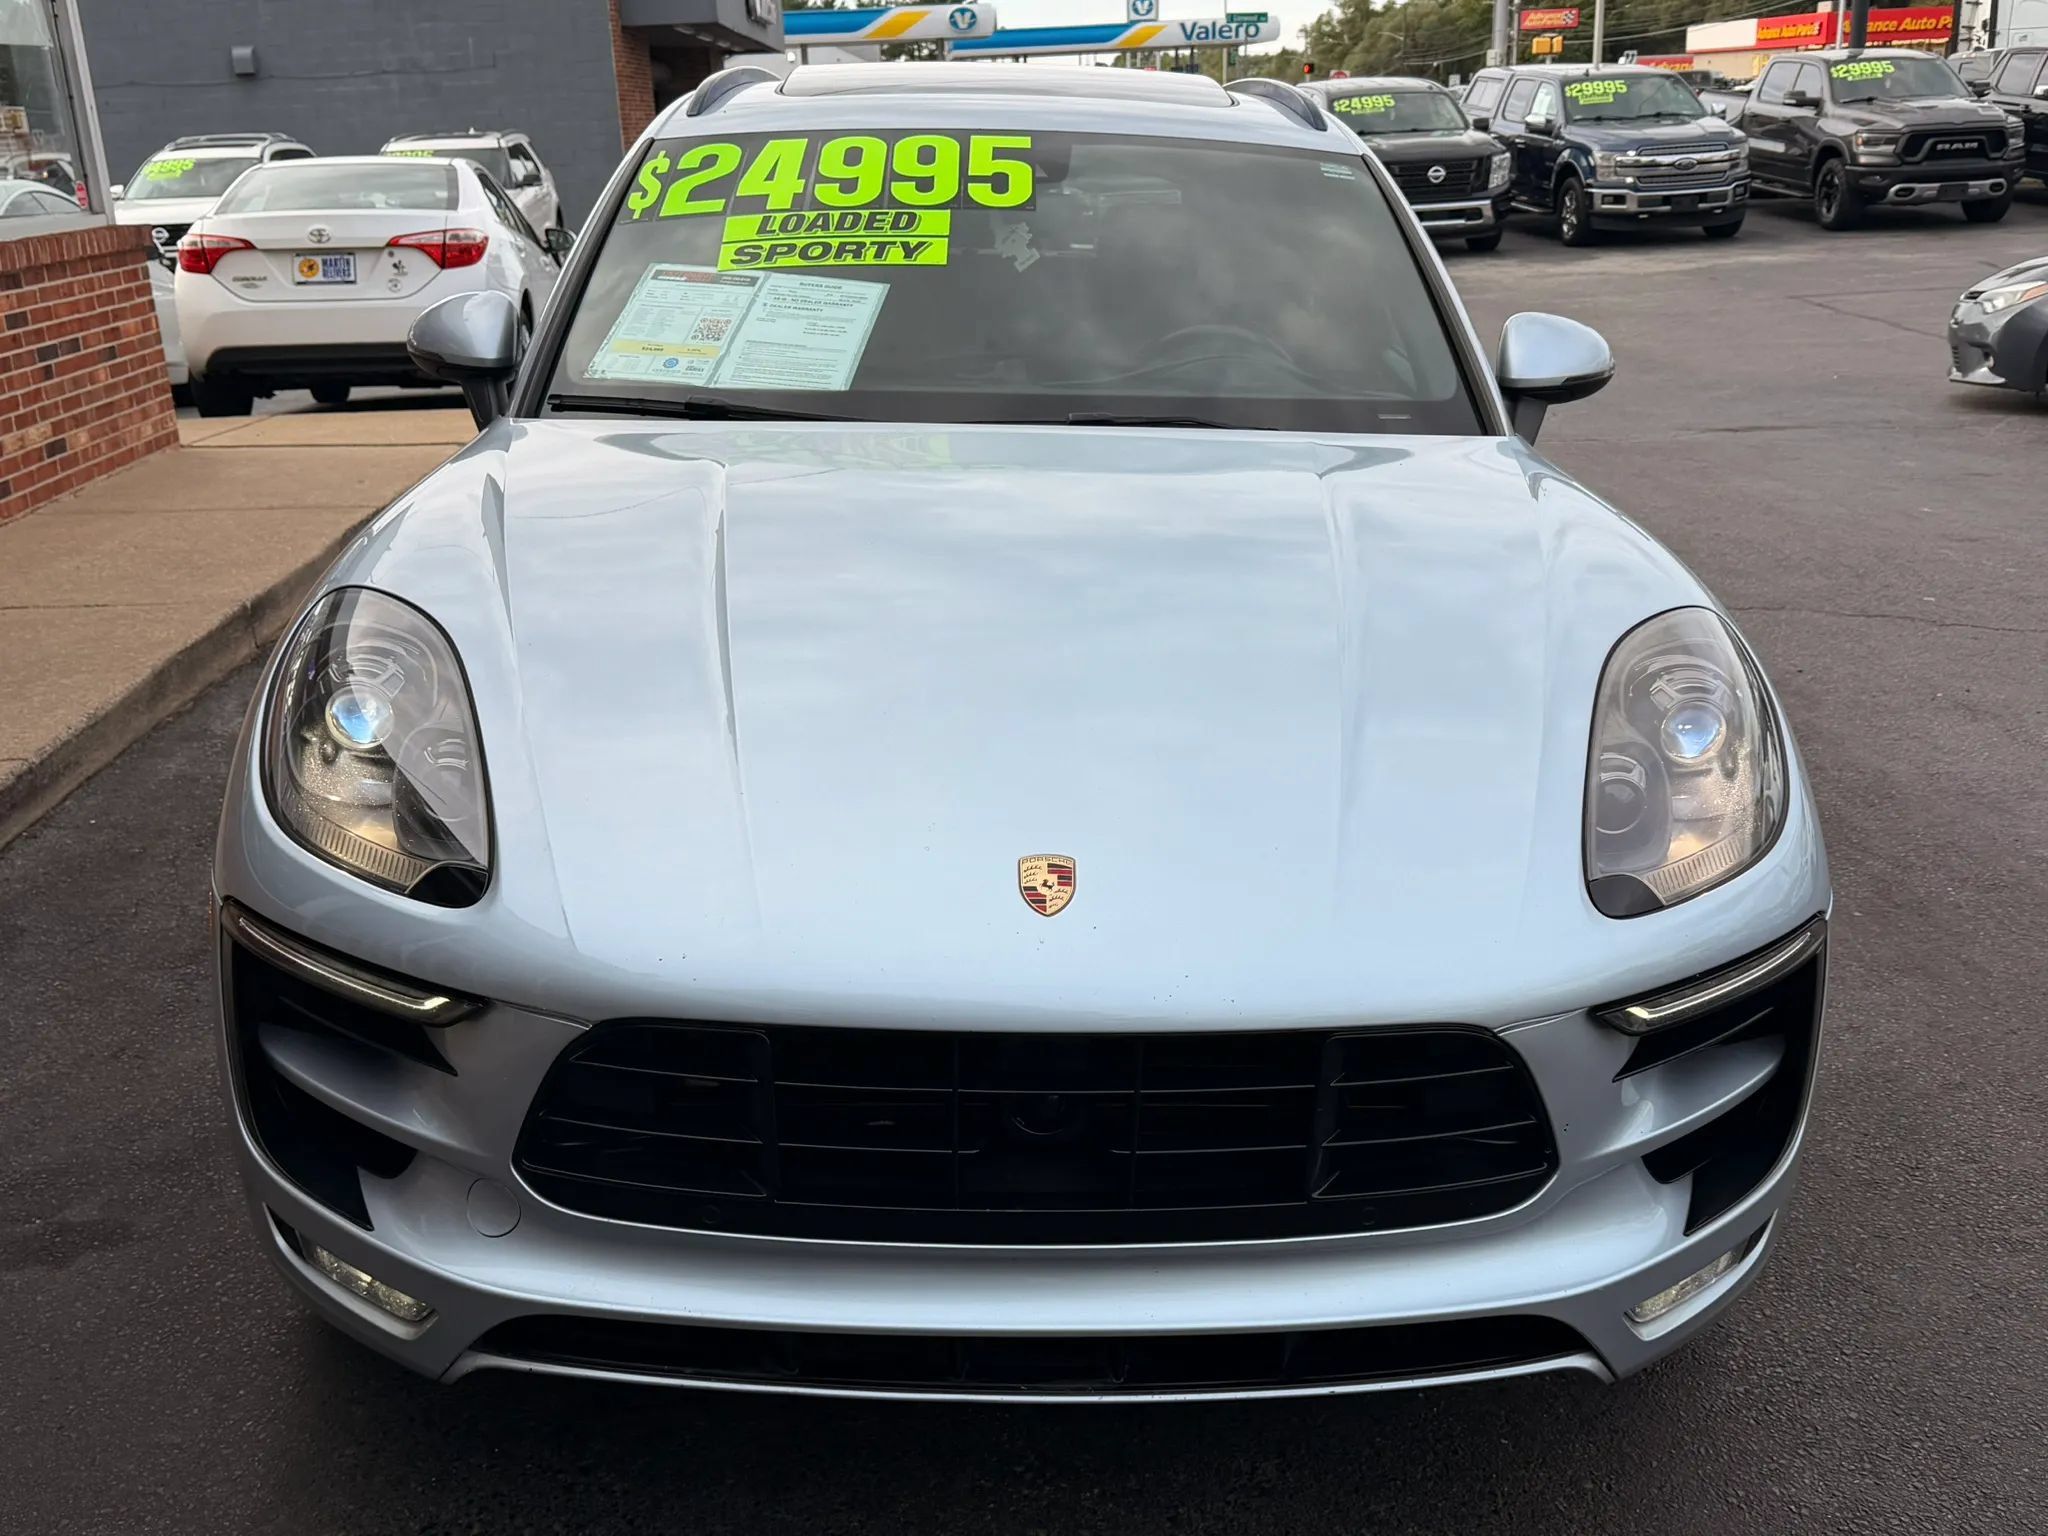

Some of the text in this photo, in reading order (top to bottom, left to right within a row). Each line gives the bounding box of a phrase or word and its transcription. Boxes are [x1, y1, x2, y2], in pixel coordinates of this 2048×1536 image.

[1179, 21, 1261, 41] Valero
[1898, 16, 1937, 31] Auto
[1937, 15, 1953, 28] P
[1830, 60, 1895, 79] $29995
[1564, 80, 1628, 97] $29995
[1333, 94, 1395, 113] $24995
[627, 135, 1034, 219] $24995
[755, 210, 922, 238] LOADED
[730, 239, 934, 267] SPORTY
[1022, 855, 1072, 865] PORSCHE
